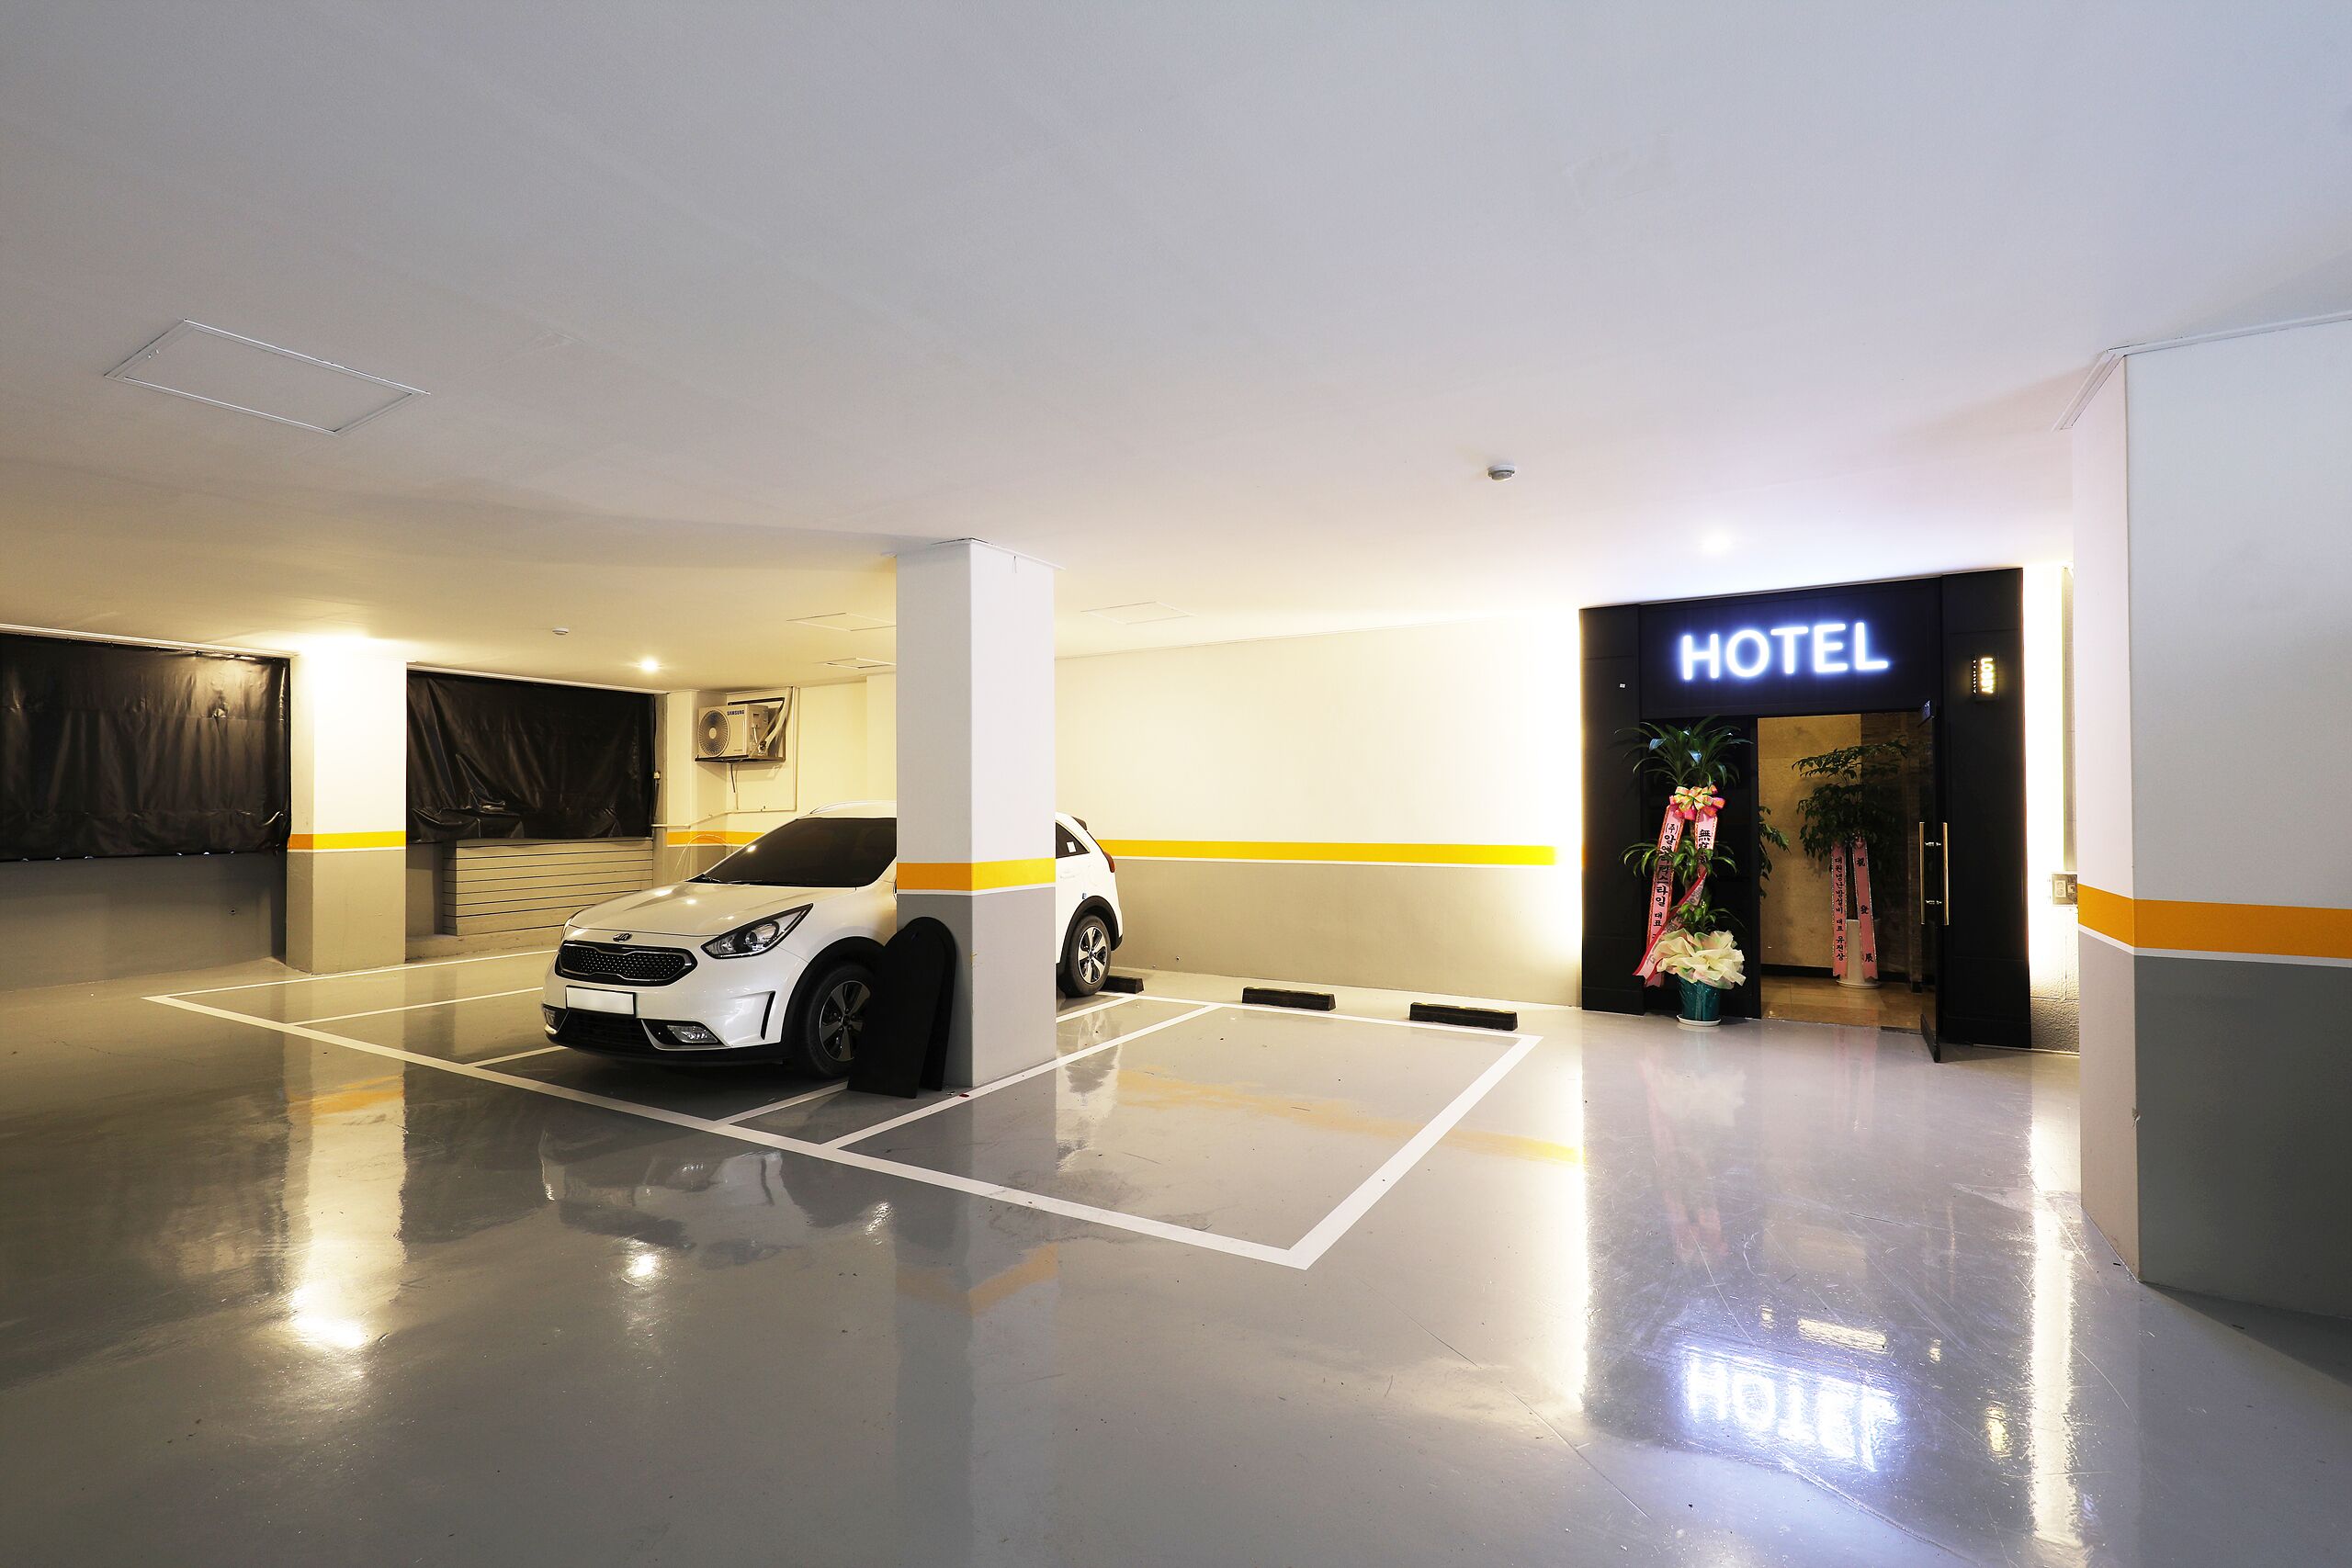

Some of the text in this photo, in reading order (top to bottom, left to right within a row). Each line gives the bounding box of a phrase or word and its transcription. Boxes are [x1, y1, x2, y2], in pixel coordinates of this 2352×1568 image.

[1682, 622, 1889, 681] HOTEL
[1981, 658, 1994, 694] LOBBY
[1654, 912, 1663, 927] 대표
[1837, 919, 1844, 931] 대표
